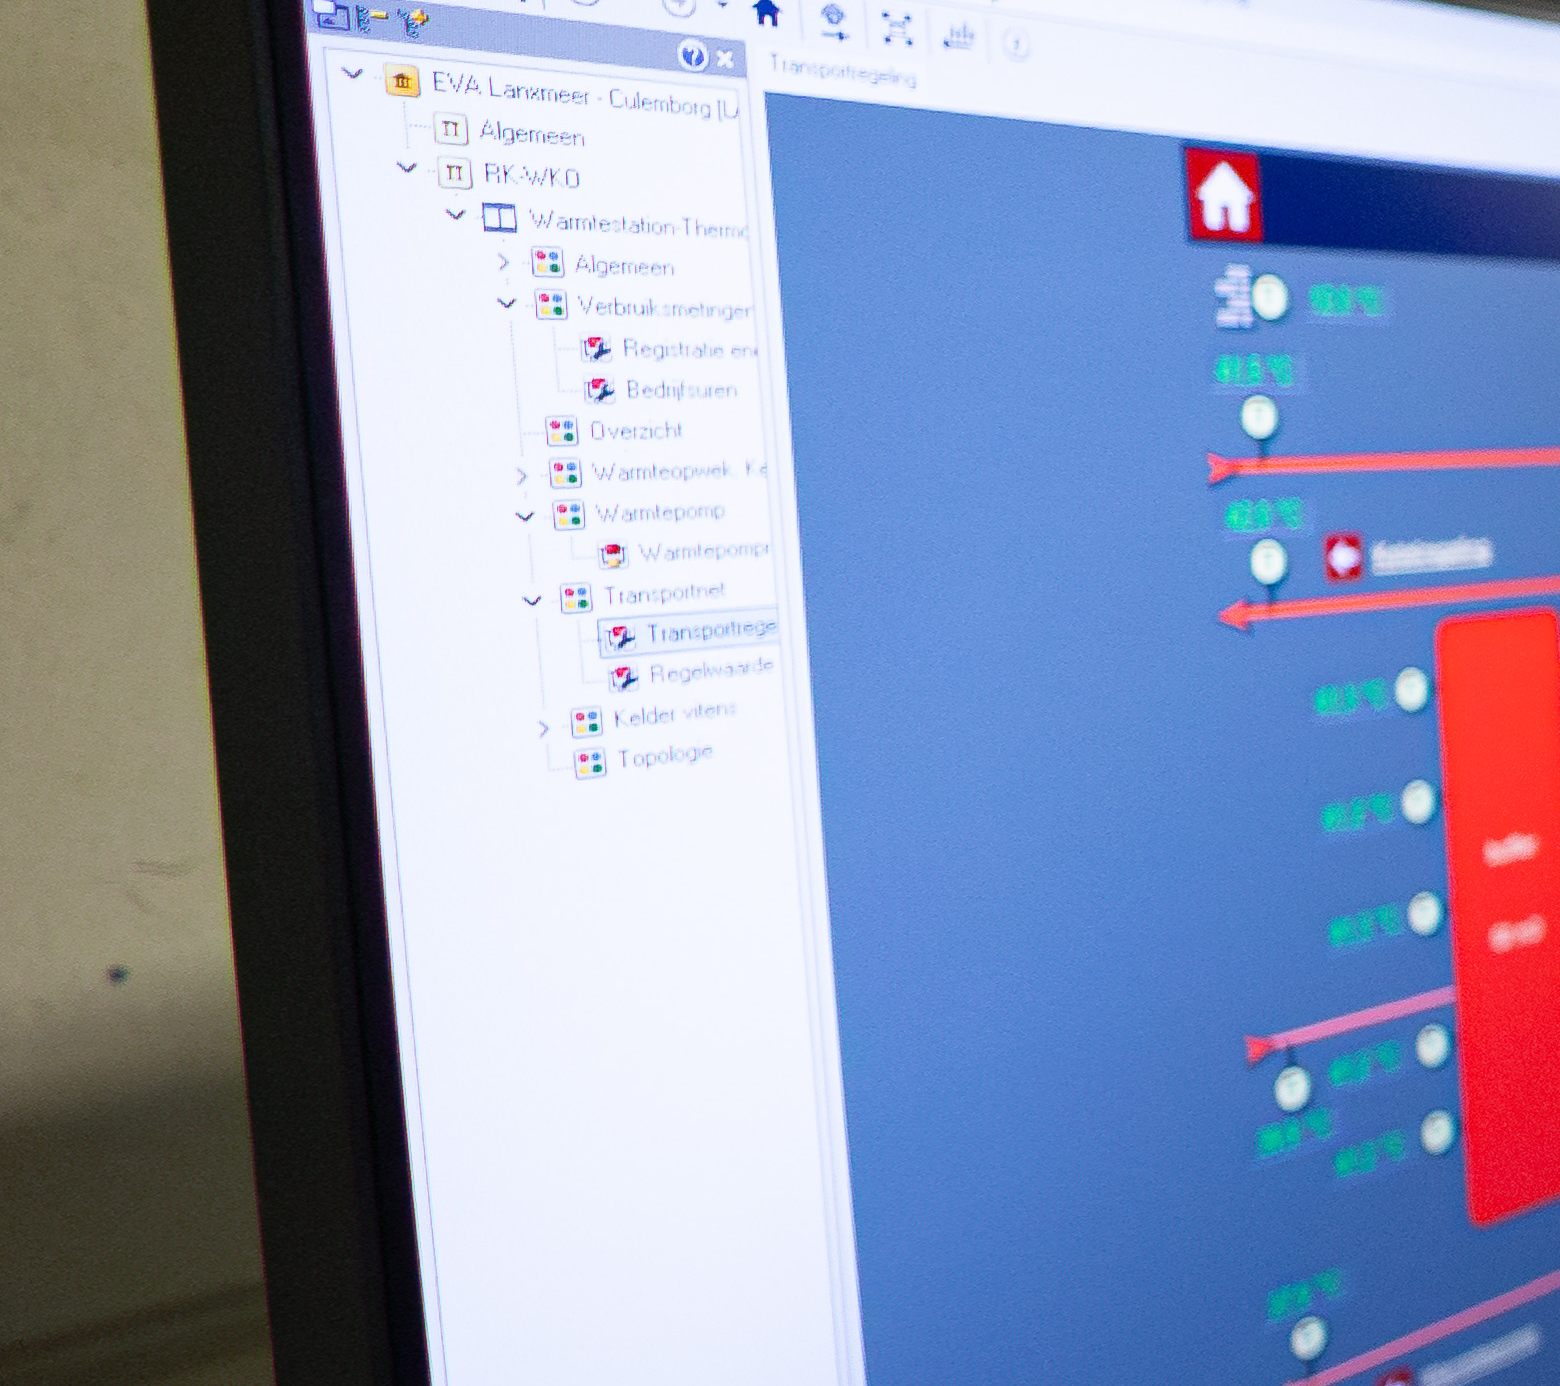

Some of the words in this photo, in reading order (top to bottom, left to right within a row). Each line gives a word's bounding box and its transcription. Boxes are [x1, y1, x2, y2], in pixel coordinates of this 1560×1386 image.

[433, 71, 481, 95] EVA
[489, 76, 590, 106] Lanxmeer
[609, 88, 710, 121] Culemborg
[480, 119, 586, 147] Algemeen
[575, 254, 676, 278] Algemeen
[624, 338, 725, 361] Registratie
[627, 379, 738, 401] Bedrijfsuren
[590, 421, 684, 441] Overzicht
[595, 503, 726, 523] Warmtepomp
[605, 583, 726, 605] Transportnet
[615, 706, 676, 728] Kelder
[619, 744, 714, 769] Topologie
